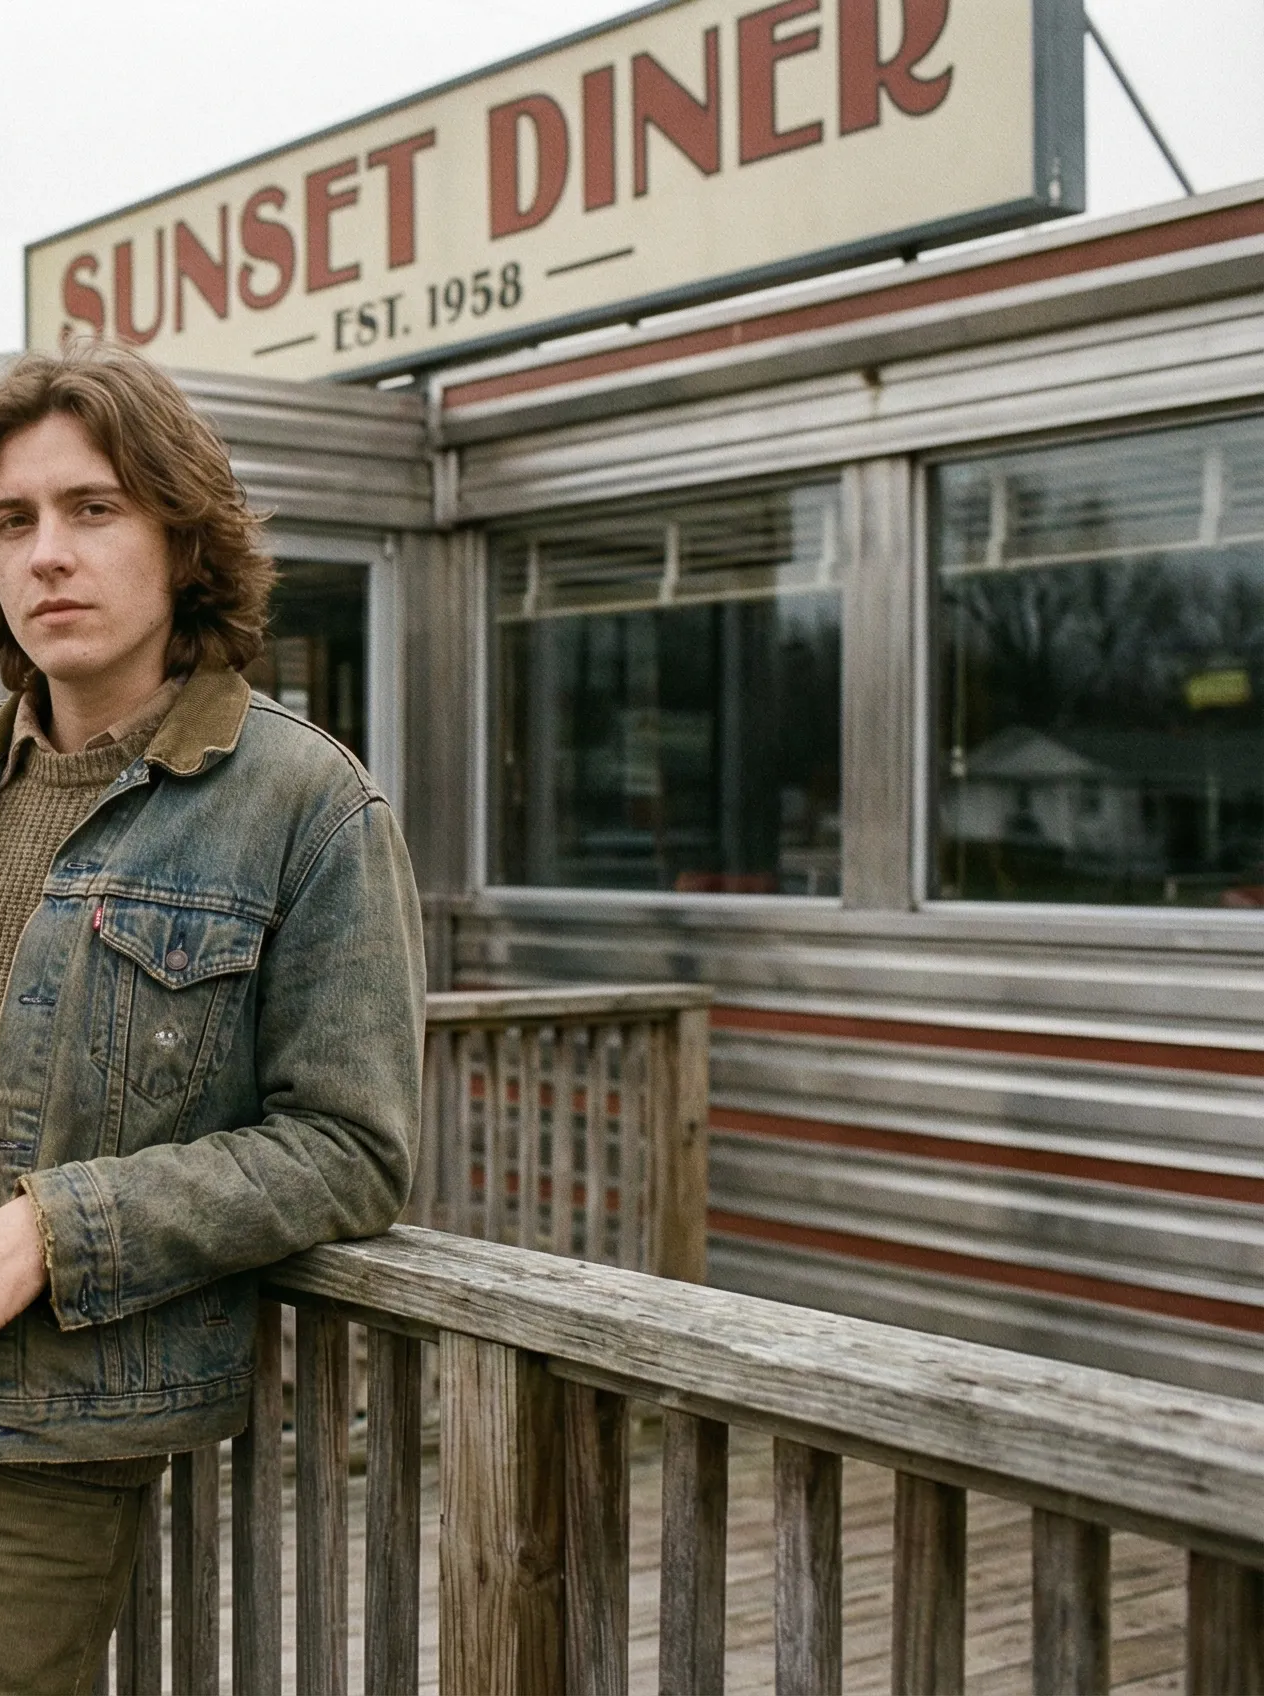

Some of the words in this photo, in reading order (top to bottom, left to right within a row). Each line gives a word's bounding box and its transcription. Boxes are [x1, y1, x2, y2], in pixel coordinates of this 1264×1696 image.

[58, 126, 438, 346] SUNSET
[488, 0, 954, 242] DINER
[333, 292, 412, 354] EST.
[426, 261, 524, 330] 1958
